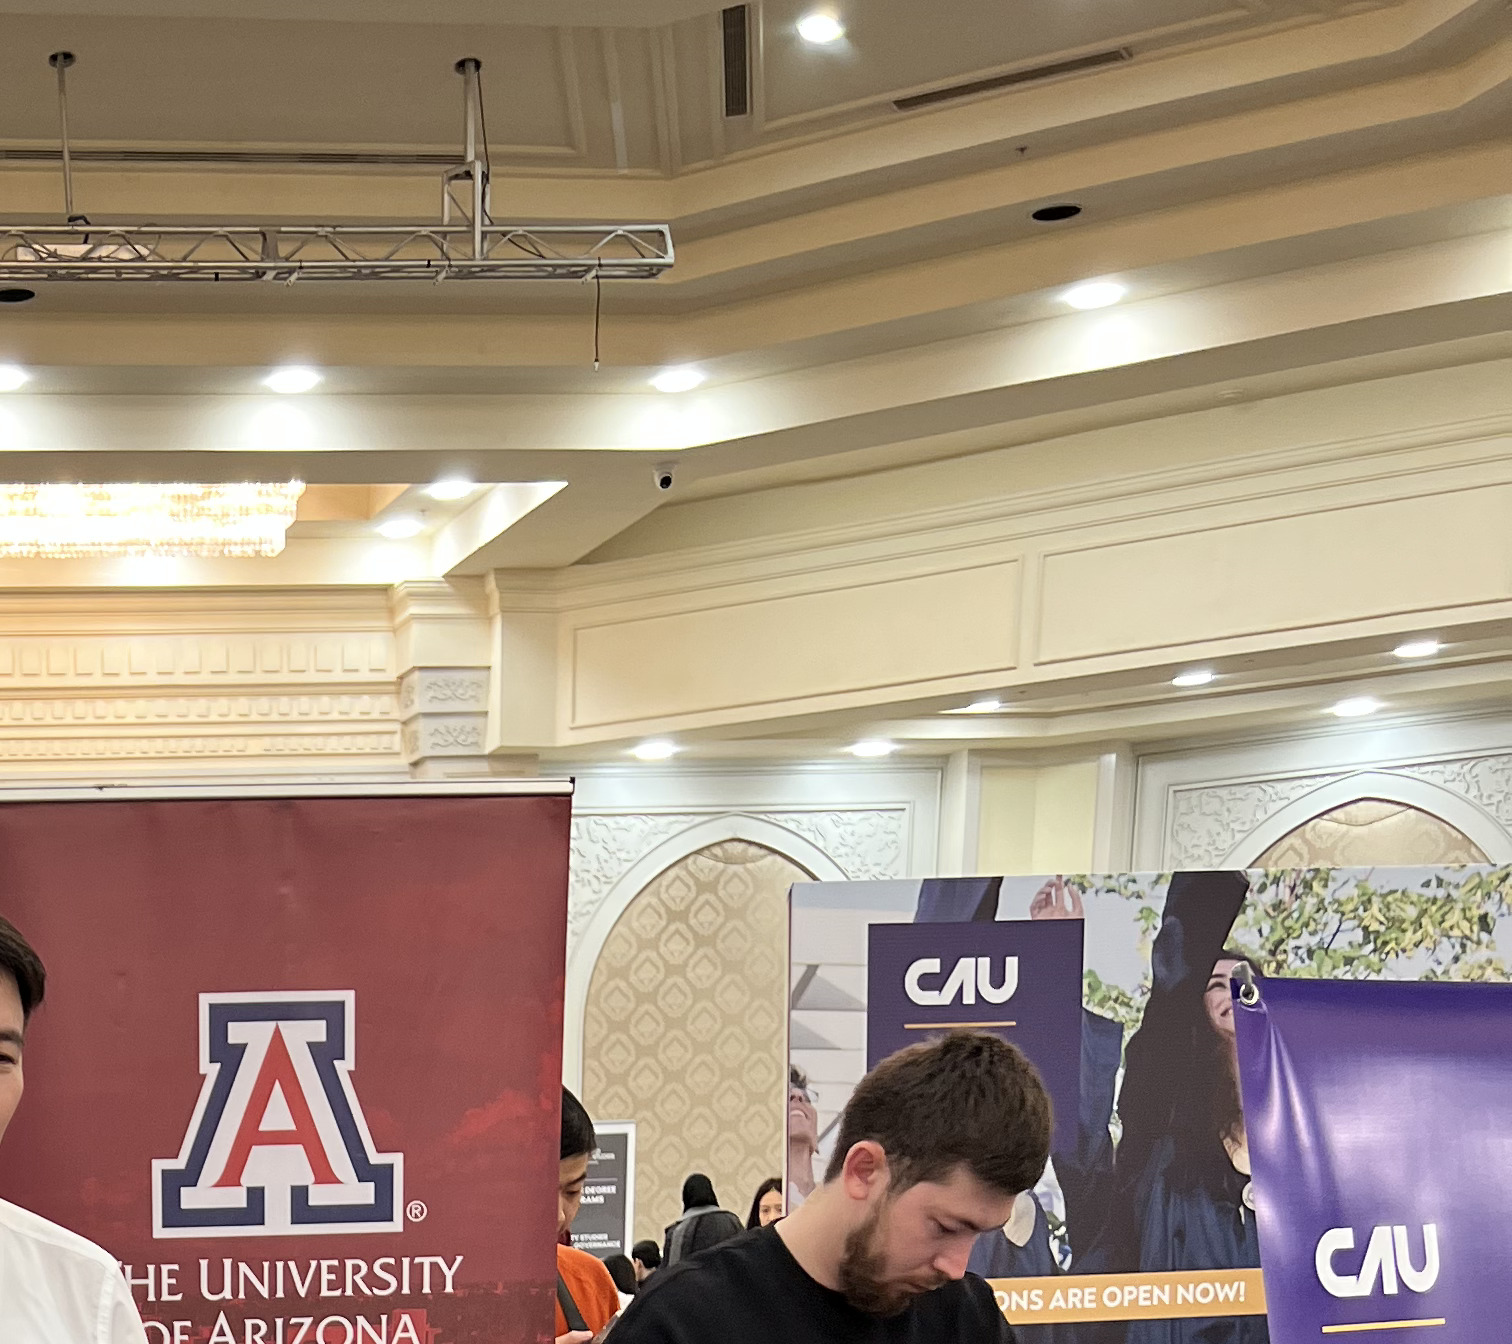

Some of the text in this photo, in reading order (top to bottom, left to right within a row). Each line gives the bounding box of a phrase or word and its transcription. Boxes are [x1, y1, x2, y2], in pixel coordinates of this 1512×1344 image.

[904, 956, 1018, 1005] CAU
[152, 990, 403, 1238] A
[580, 1195, 605, 1204] RAMS
[199, 1255, 463, 1300] UNIVERSITY
[1315, 1223, 1439, 1297] CAU
[994, 1281, 1246, 1312] ONS ARE OPEN NOW!
